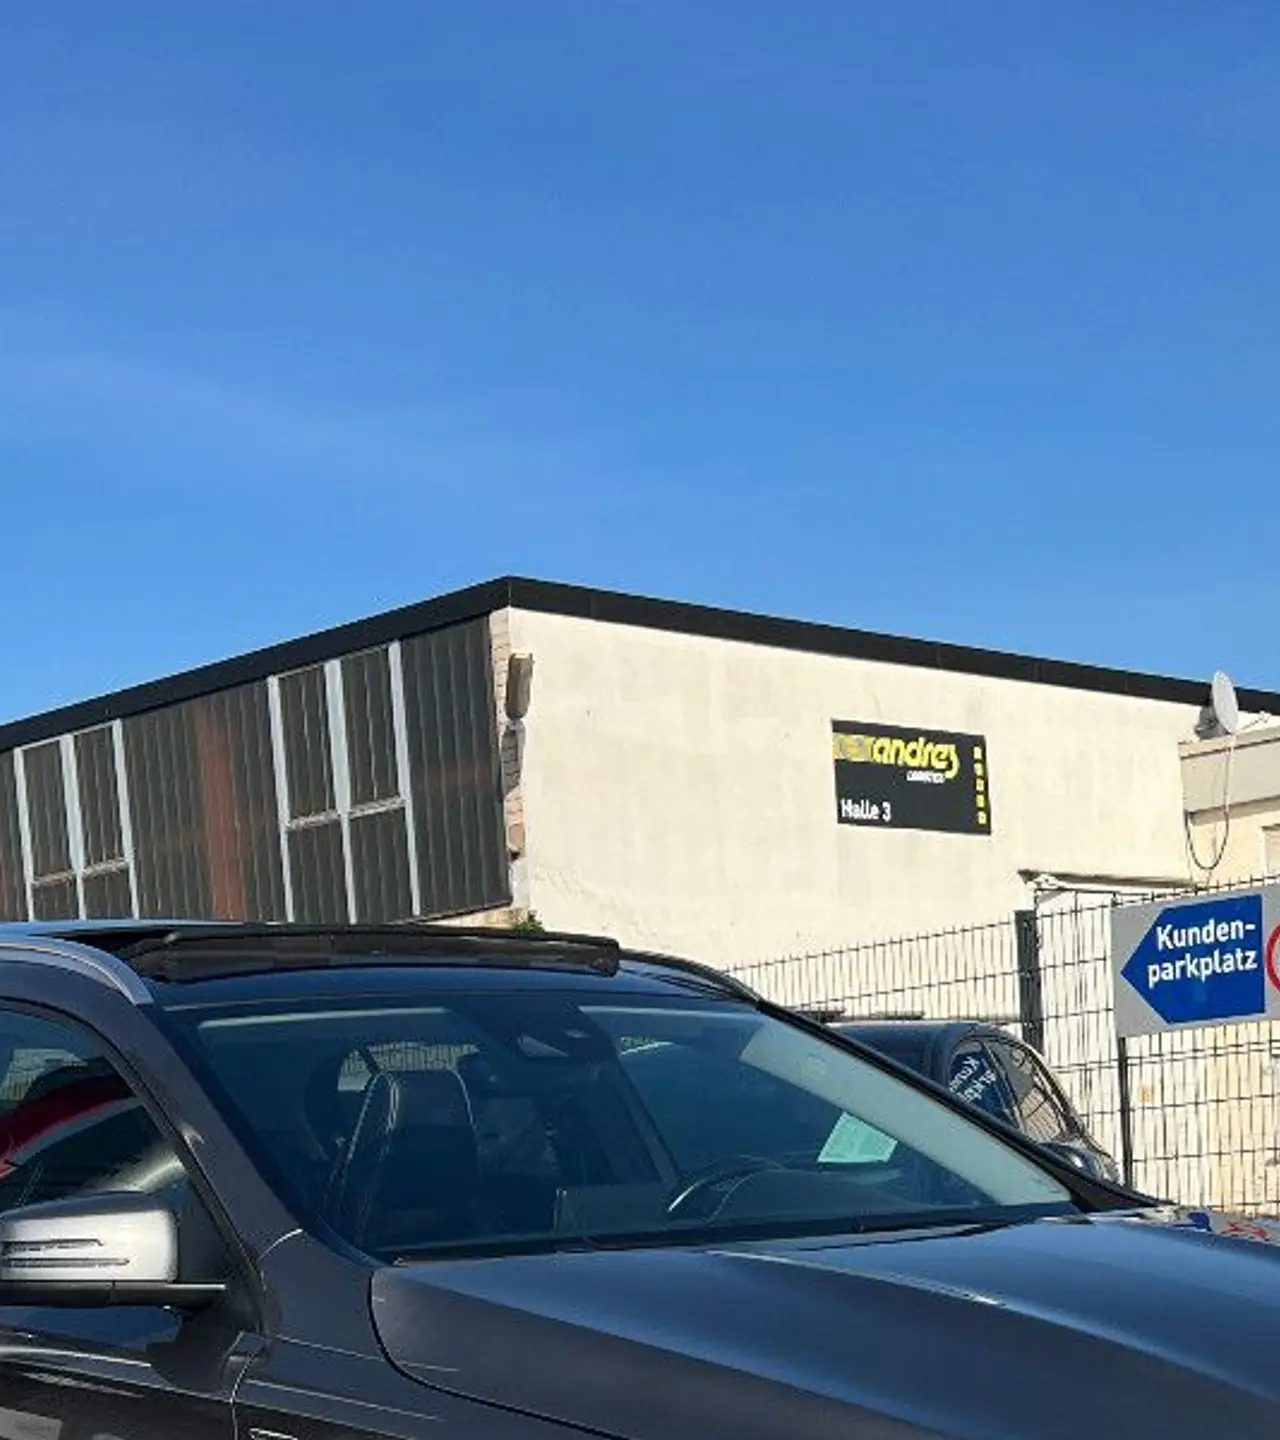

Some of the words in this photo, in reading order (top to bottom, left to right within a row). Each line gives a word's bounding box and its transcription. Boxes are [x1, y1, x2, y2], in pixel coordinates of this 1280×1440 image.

[840, 798, 880, 820] Halle
[882, 801, 892, 821] 3
[1156, 917, 1257, 951] Kunden-
[1147, 947, 1259, 990] parkplatz
